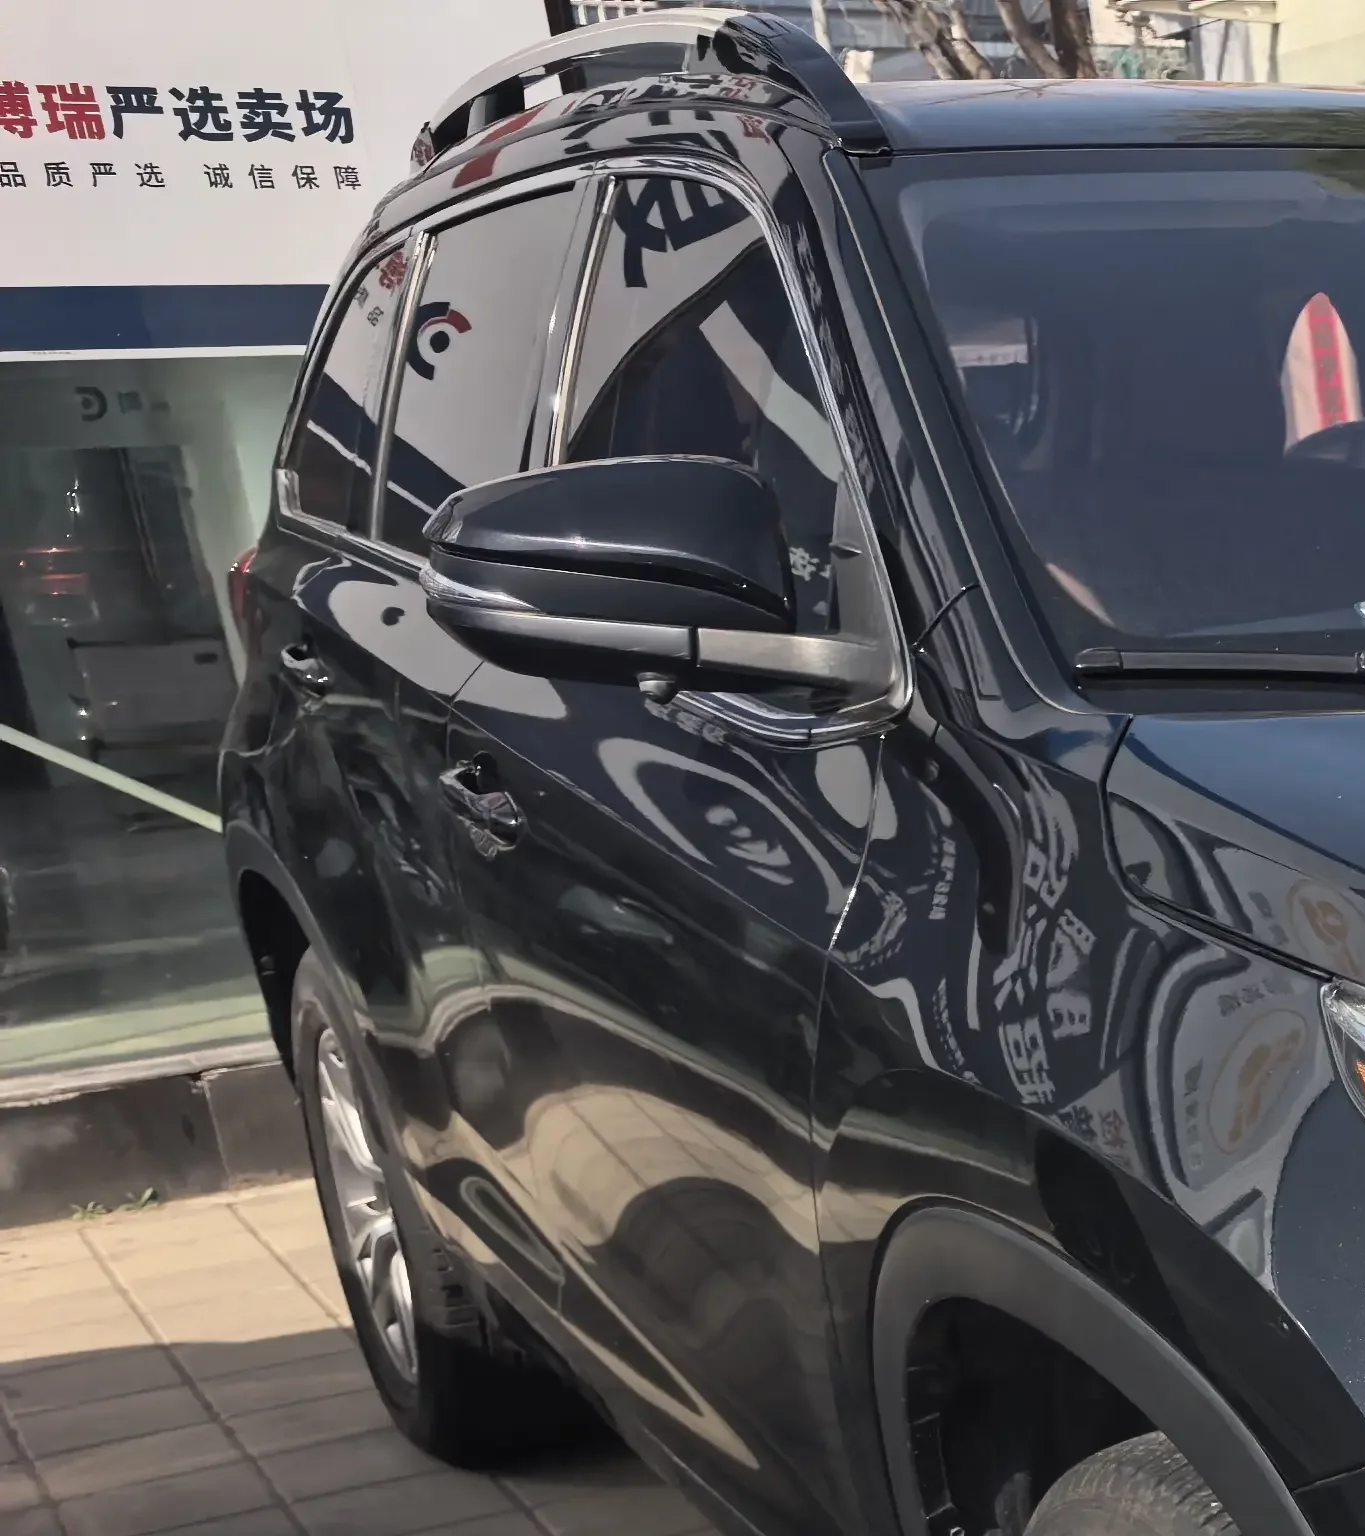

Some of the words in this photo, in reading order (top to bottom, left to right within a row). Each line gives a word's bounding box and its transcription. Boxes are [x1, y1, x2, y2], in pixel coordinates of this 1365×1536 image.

[0, 161, 166, 189] 品质严选
[203, 163, 363, 191] 诚信保障
